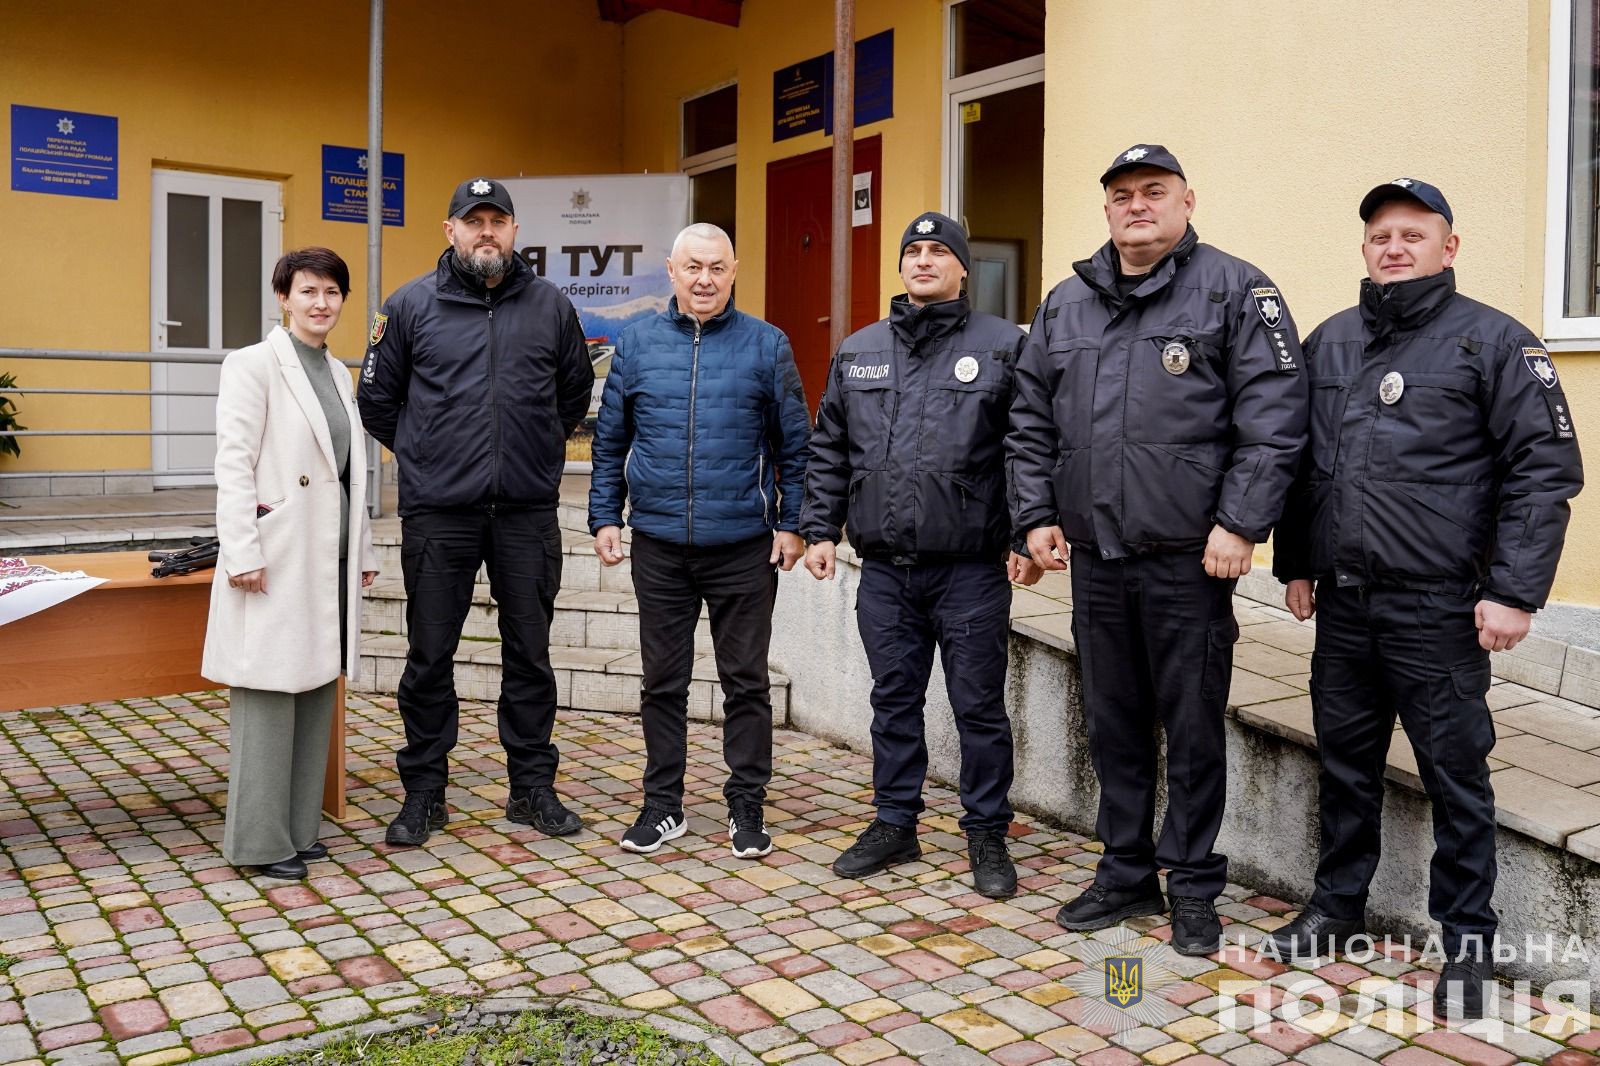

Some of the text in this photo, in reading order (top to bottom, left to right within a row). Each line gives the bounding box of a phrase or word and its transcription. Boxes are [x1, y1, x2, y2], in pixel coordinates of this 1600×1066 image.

[85, 154, 113, 162] ГРОМАДИ
[330, 176, 396, 190] ПОЛІЦЕКА
[561, 245, 643, 277] ТУТ
[560, 282, 630, 298] оберігати
[848, 364, 890, 379] ПОЛІЦІЯ
